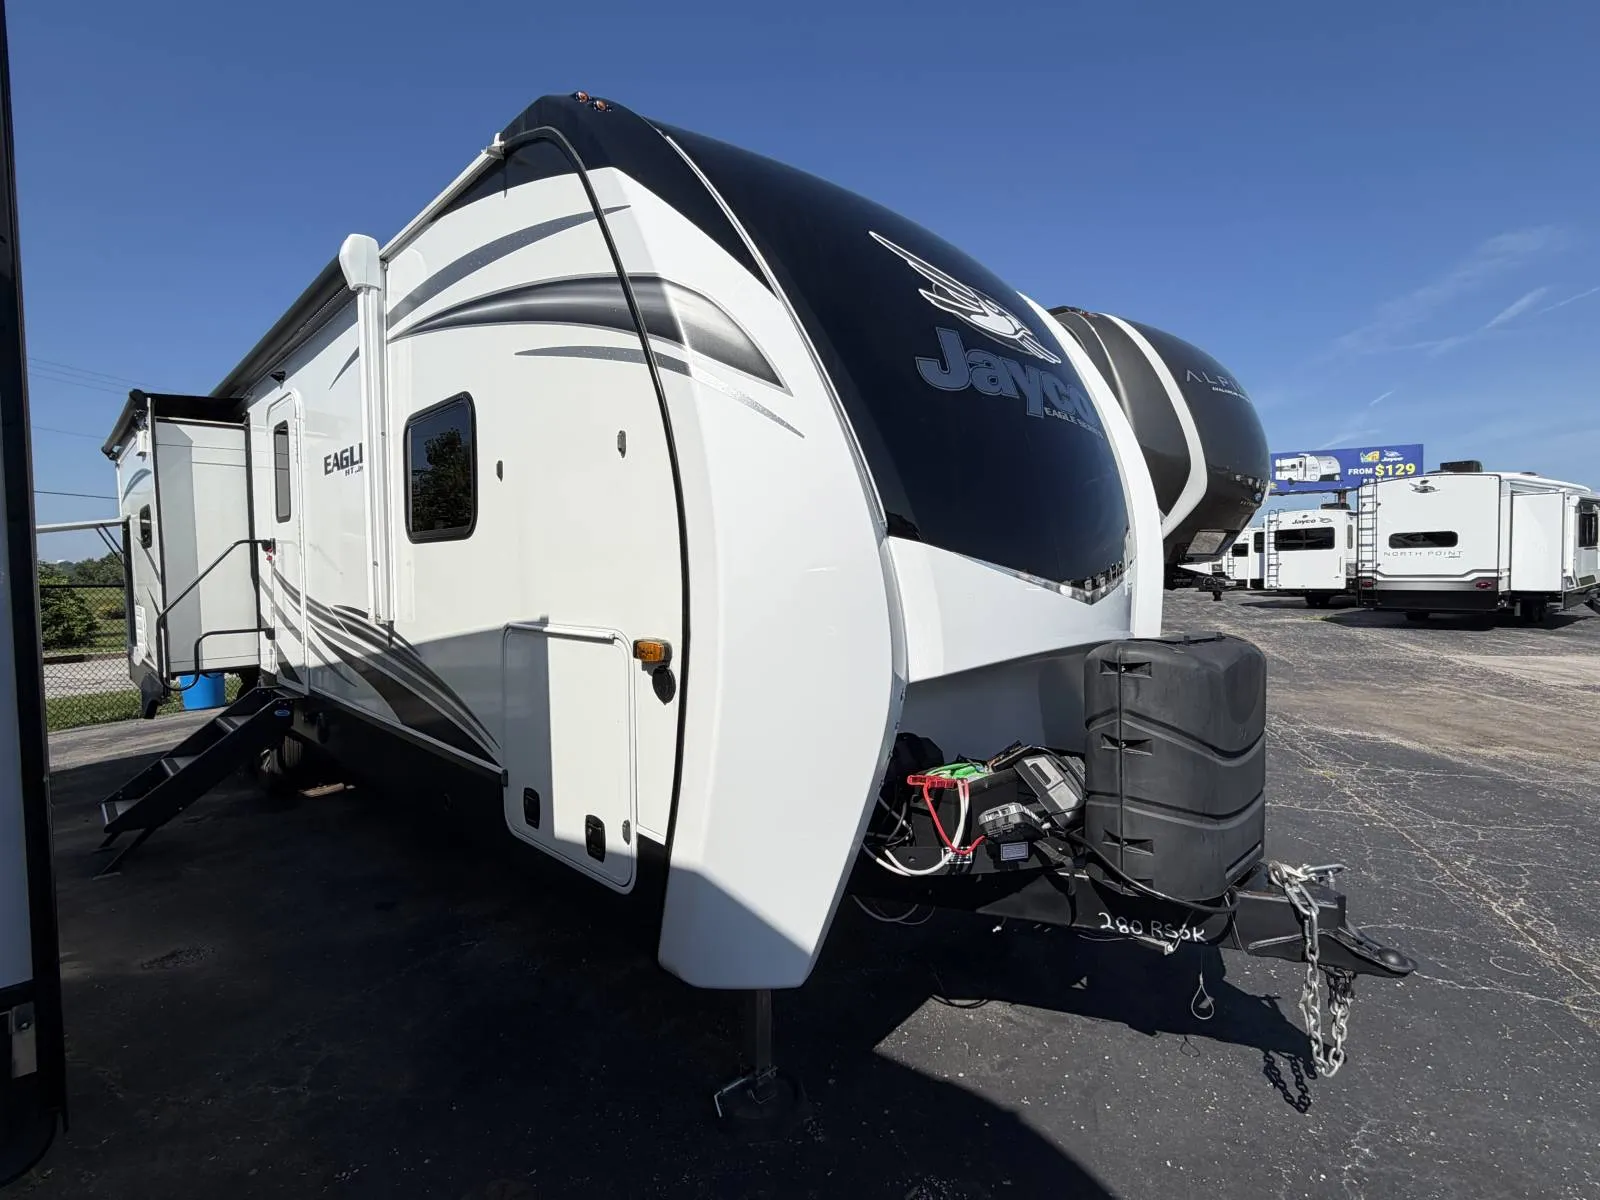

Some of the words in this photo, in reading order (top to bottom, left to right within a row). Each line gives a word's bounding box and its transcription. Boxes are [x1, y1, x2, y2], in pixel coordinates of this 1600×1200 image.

[915, 326, 1099, 427] Jayco
[1044, 406, 1078, 425] EAGLE
[1375, 463, 1416, 477] $129
[1098, 912, 1143, 936] 280
